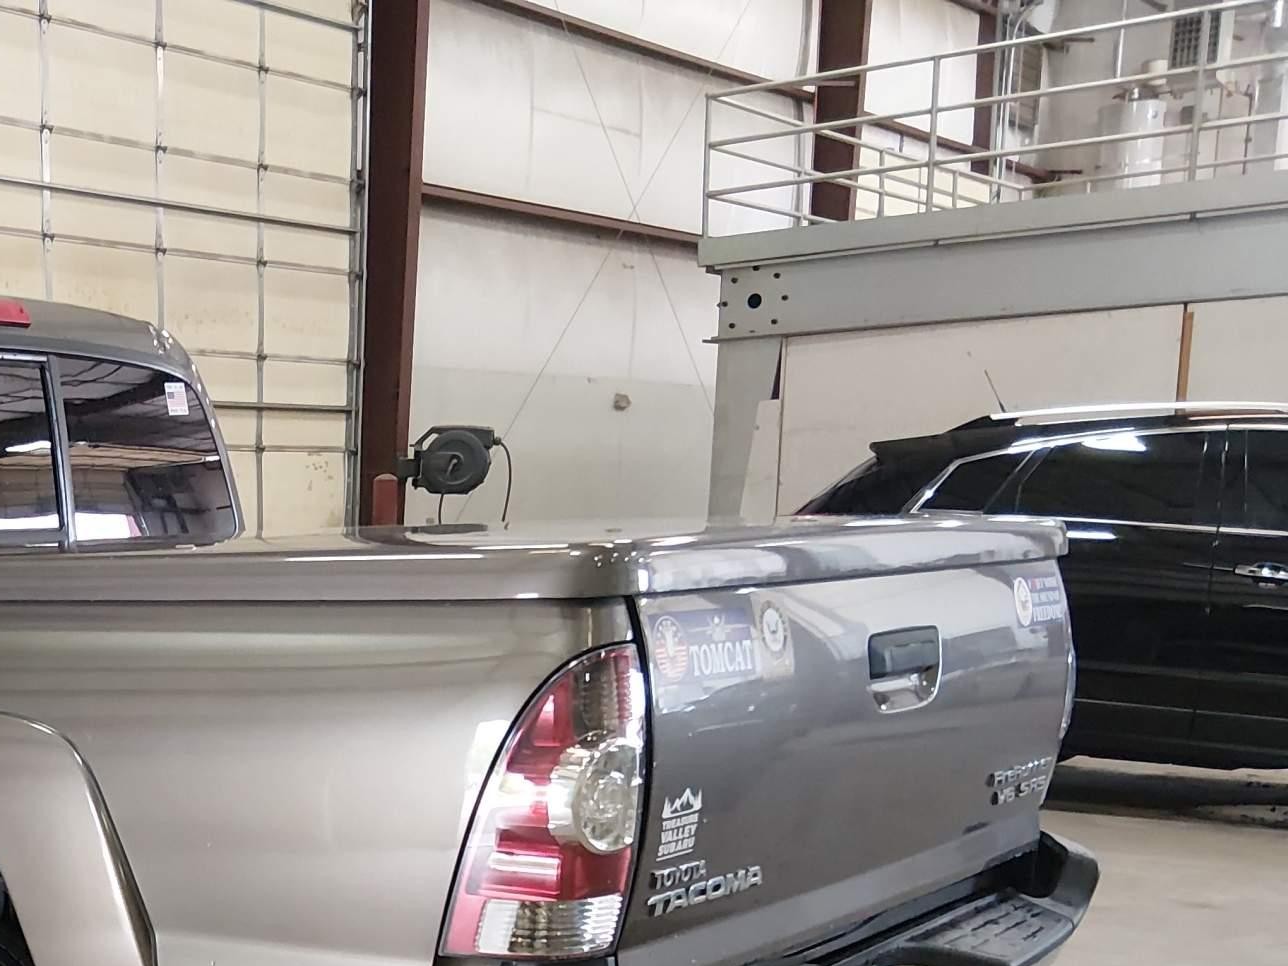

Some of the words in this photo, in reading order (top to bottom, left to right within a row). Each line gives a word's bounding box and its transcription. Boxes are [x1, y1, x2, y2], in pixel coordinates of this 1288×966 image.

[689, 640, 753, 676] TOMCAT
[657, 836, 695, 857] SUBARU
[661, 823, 698, 844] VALLEY
[651, 859, 707, 890] TOYOTA
[647, 865, 763, 917] TACOMA
